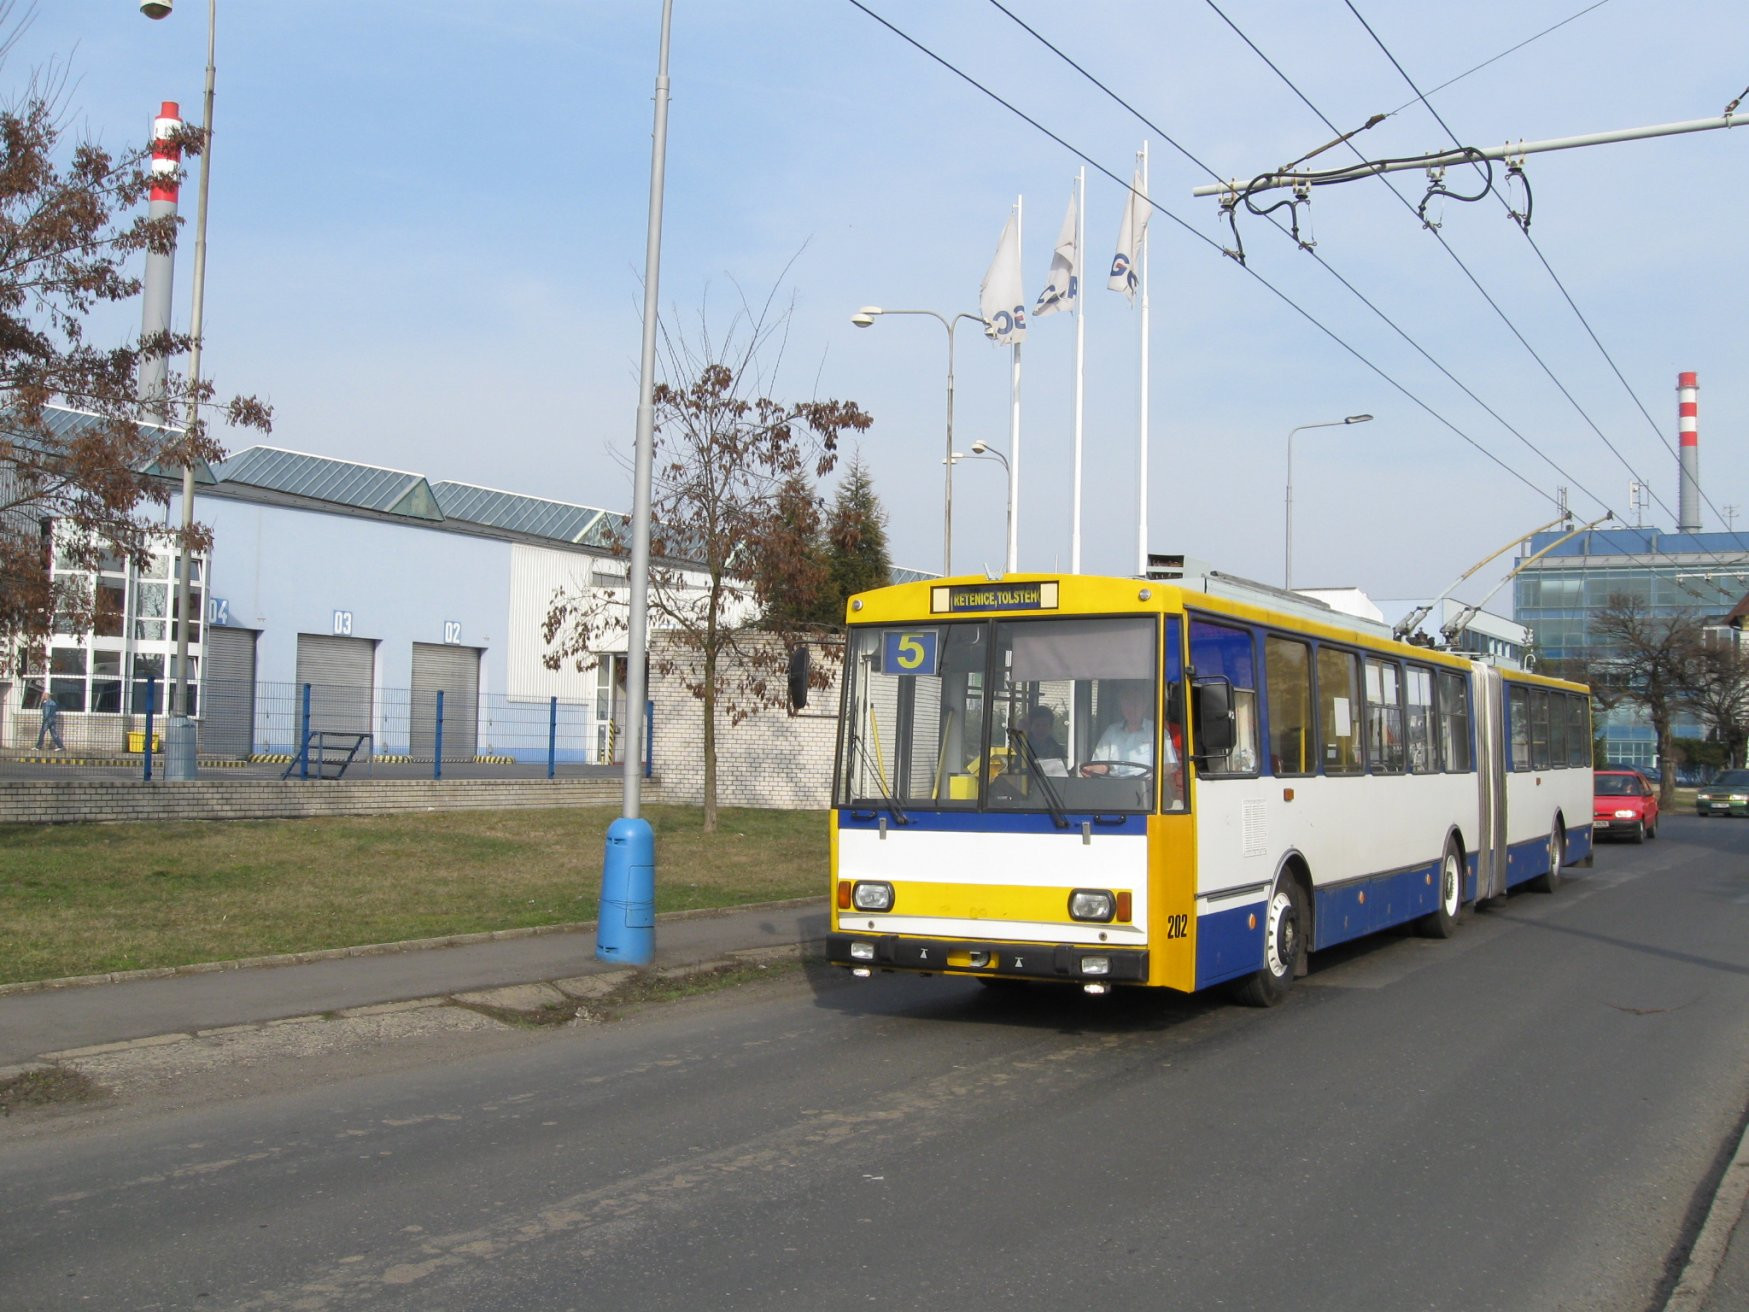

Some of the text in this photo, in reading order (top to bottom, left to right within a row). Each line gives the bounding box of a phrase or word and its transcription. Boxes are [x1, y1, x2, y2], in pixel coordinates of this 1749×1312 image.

[209, 599, 228, 625] 04
[335, 611, 352, 634] 03
[445, 622, 461, 644] 02
[897, 632, 925, 669] 5
[1167, 914, 1188, 939] 202
